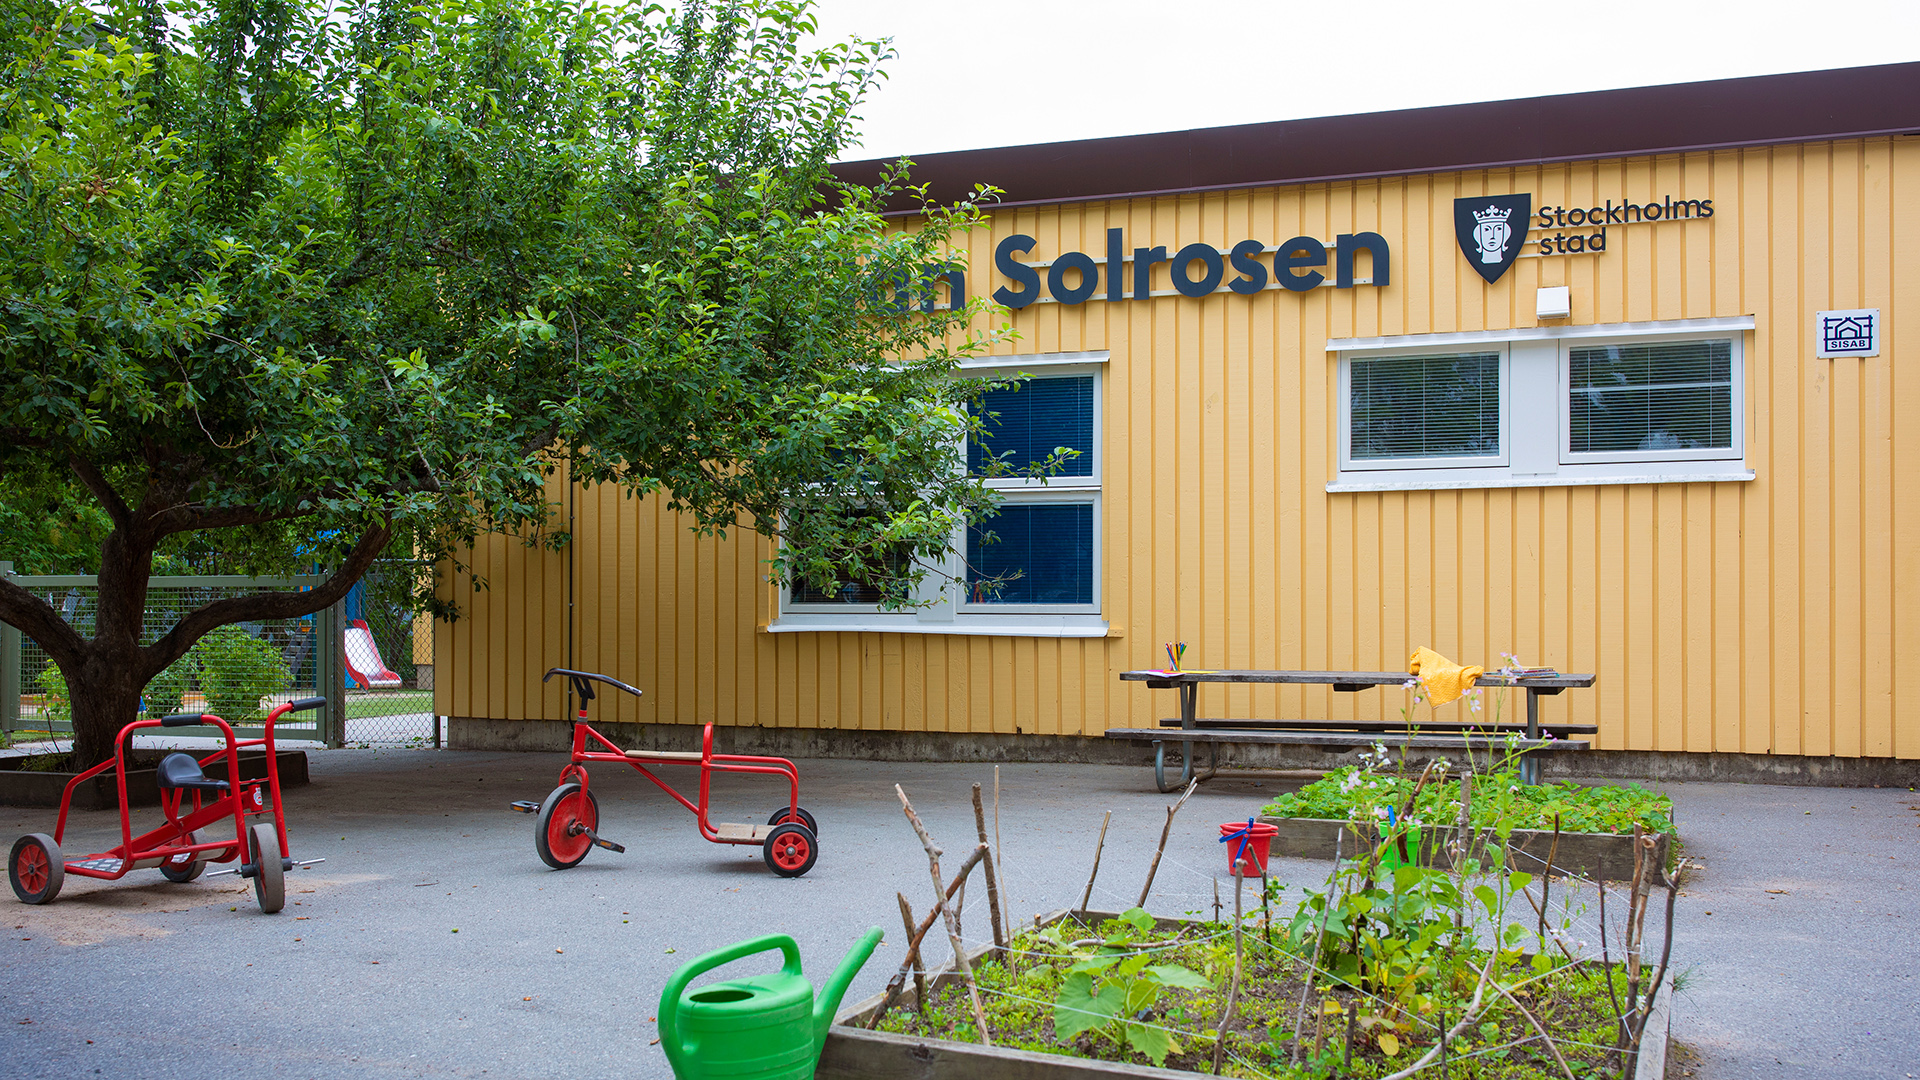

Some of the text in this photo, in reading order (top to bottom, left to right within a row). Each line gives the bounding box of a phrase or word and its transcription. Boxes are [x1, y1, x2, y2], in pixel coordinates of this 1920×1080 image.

[1538, 194, 1715, 229] Stockholms
[1539, 226, 1607, 256] stad
[991, 227, 1391, 309] Solrosen
[1830, 339, 1866, 349] SISAB
